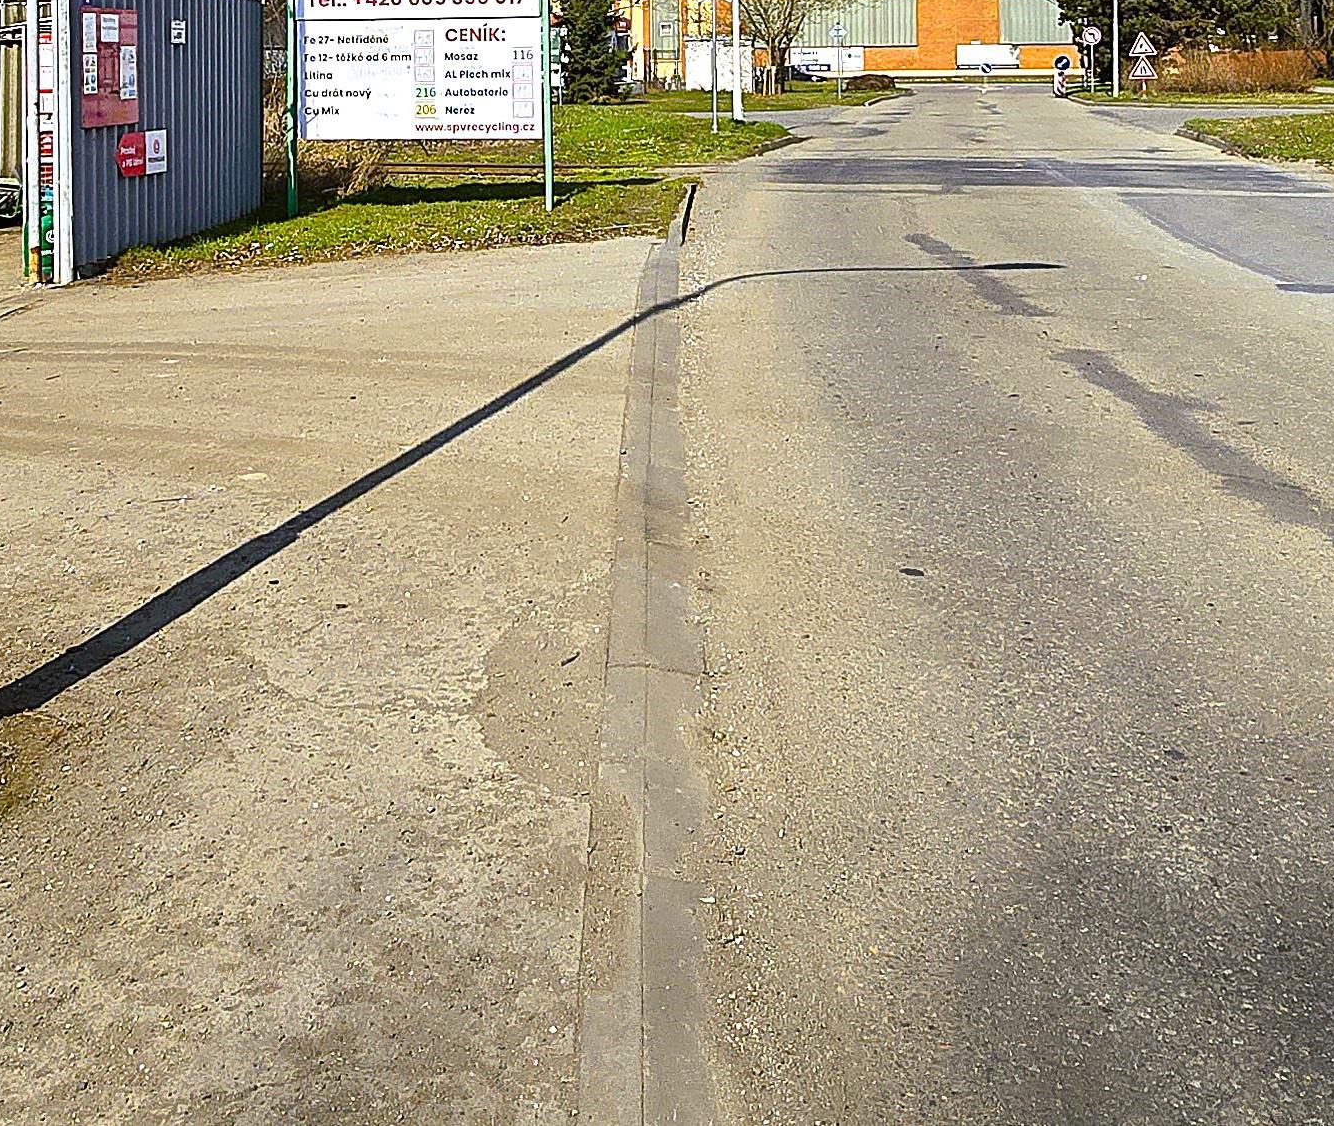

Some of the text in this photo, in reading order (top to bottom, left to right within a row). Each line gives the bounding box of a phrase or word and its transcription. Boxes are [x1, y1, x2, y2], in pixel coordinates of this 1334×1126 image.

[445, 23, 506, 42] CENÍK:
[366, 53, 379, 62] od
[381, 53, 388, 61] 6
[390, 53, 412, 61] mm
[444, 52, 479, 61] Mosaz
[513, 50, 534, 60] 116
[444, 70, 457, 79] AL
[459, 70, 488, 78] Plech
[490, 69, 511, 78] mix
[304, 87, 372, 100] Cu drát nový
[415, 87, 437, 98] 216
[445, 87, 509, 97] Autobaterie
[304, 106, 340, 116] Cu Mix
[415, 104, 437, 115] 206
[445, 106, 475, 115] Nerez
[415, 122, 535, 134] www.spvrecycling.cz
